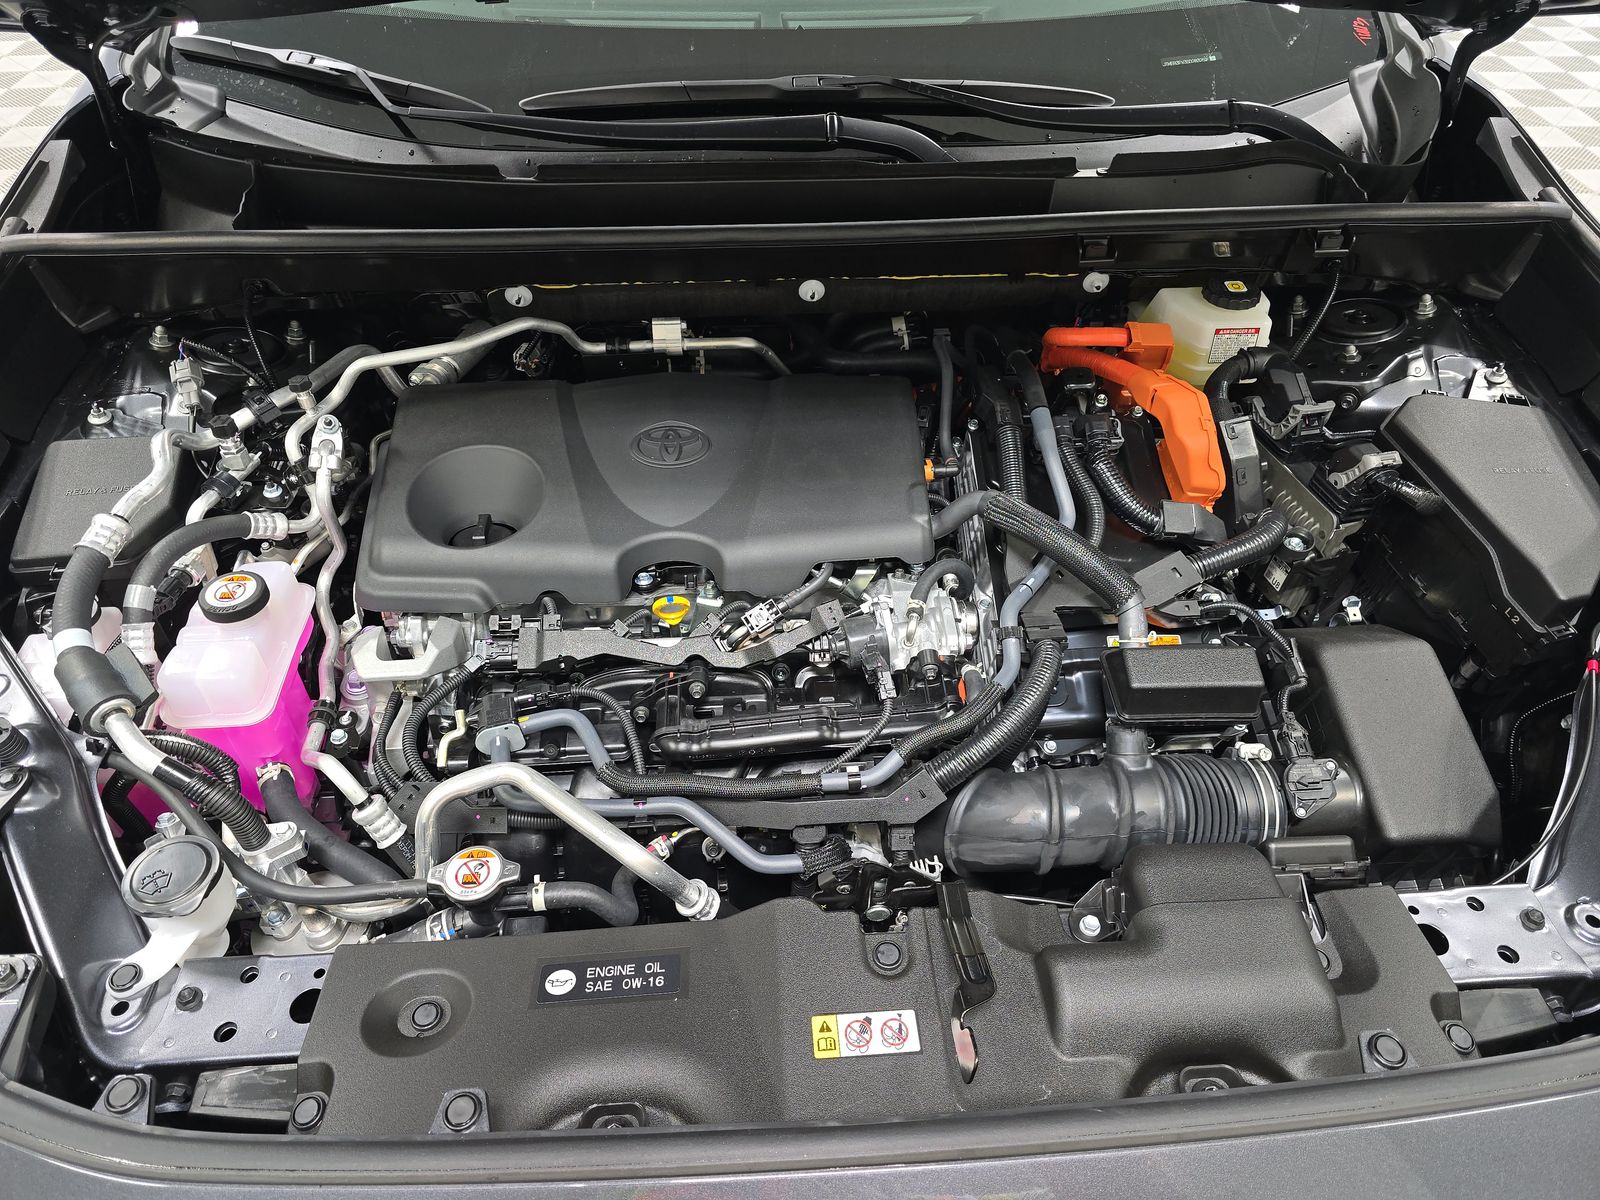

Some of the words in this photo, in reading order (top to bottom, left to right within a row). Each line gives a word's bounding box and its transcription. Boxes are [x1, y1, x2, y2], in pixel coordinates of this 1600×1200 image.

[65, 487, 100, 496] RELAY
[1504, 607, 1520, 625] L2
[586, 963, 636, 979] ENGINE
[644, 961, 666, 974] OIL
[585, 979, 613, 993] SAE
[622, 975, 665, 990] 0W-16
